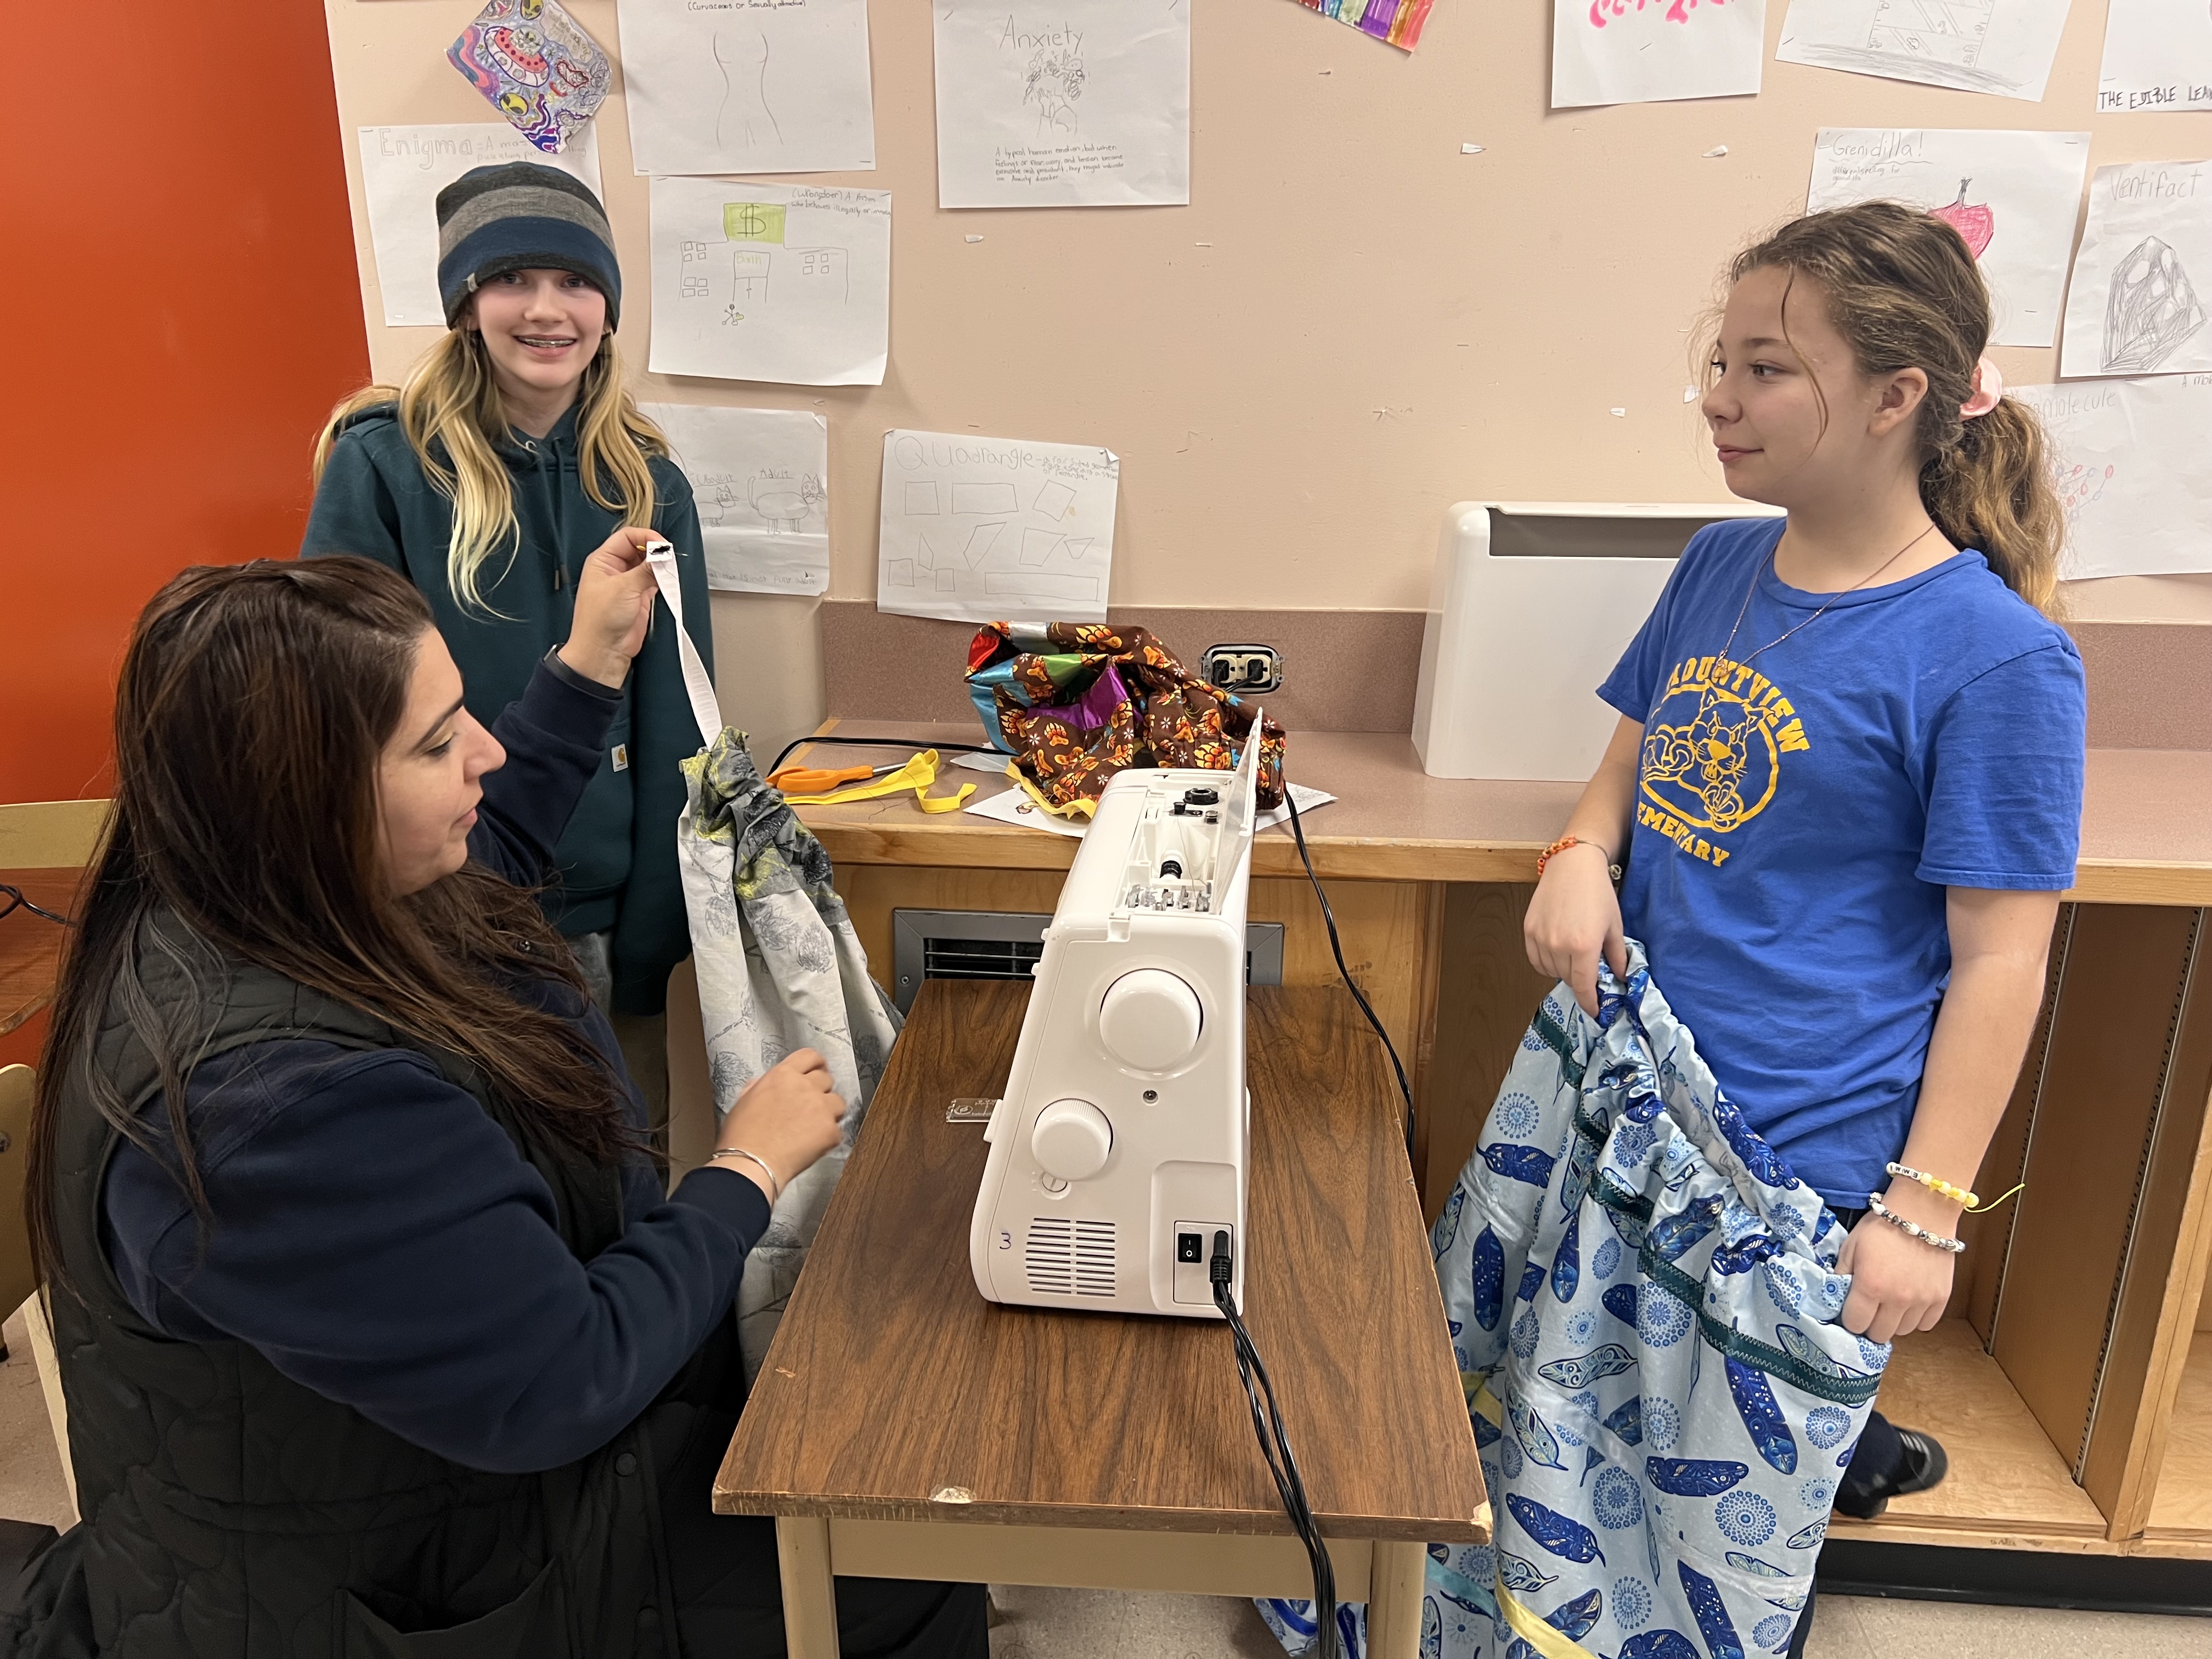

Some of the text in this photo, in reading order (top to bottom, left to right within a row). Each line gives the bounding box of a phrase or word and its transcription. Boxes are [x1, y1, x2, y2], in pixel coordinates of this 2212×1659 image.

[999, 14, 1084, 54] Anxiety
[2099, 91, 2123, 109] THE
[2130, 86, 2177, 109] EDIBLE
[379, 127, 473, 170] Enigma
[2111, 167, 2203, 201] Ventifact
[999, 1232, 1012, 1250] 3
